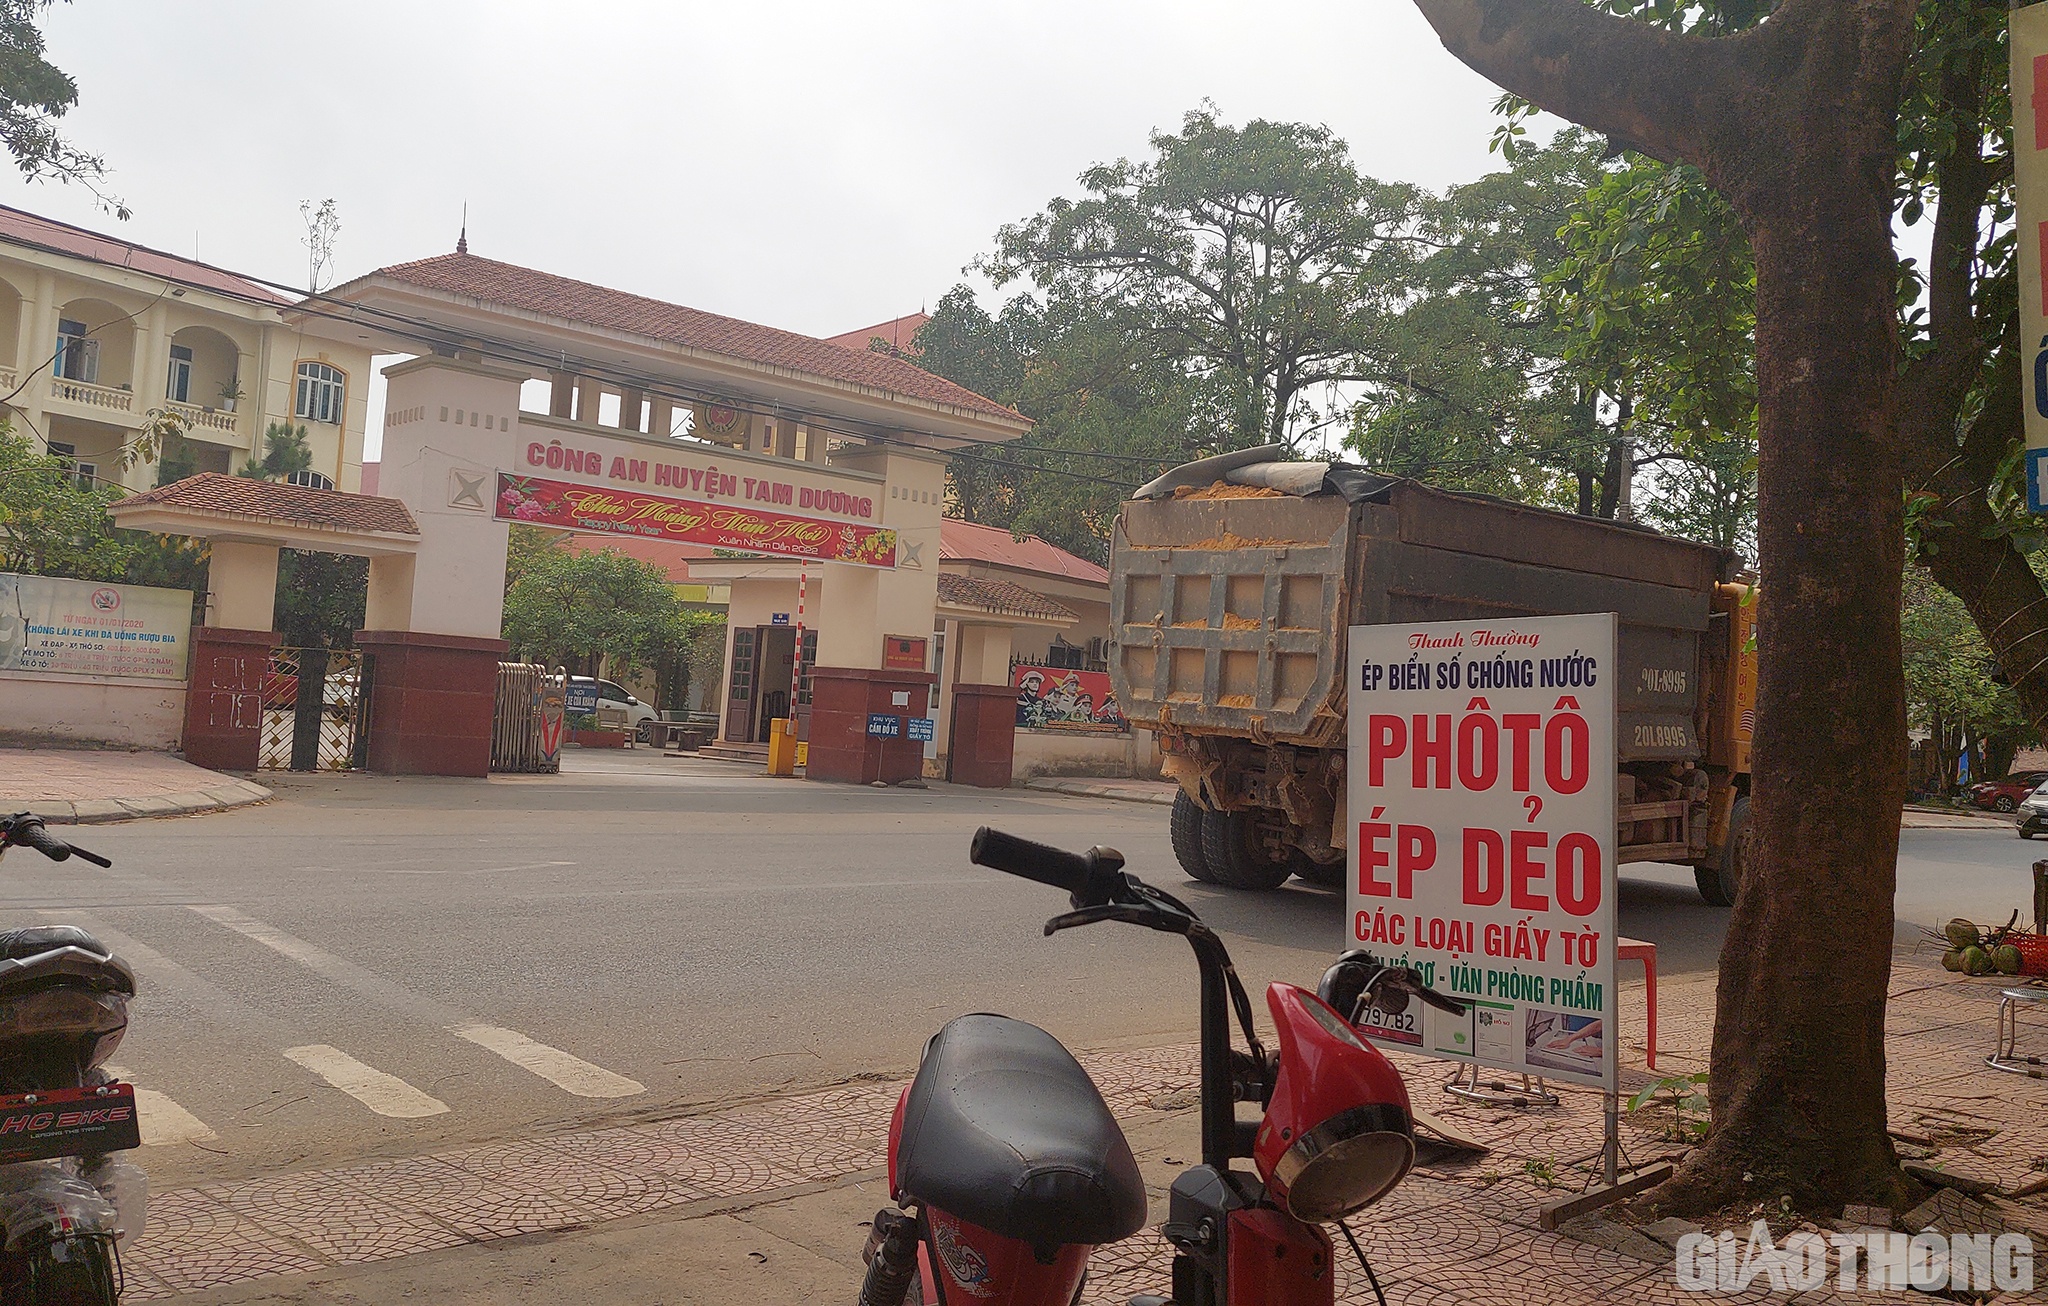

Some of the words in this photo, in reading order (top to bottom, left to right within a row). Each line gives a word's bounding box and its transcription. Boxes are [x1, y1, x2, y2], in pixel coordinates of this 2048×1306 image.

[527, 439, 601, 475] CÔNG
[608, 456, 648, 483] AN
[654, 463, 737, 499] HUYỆN
[743, 477, 793, 506] TAM
[798, 487, 873, 518] DƯƠNG
[563, 490, 630, 519] Chúc
[577, 516, 613, 531] Happy
[613, 521, 638, 533] New
[638, 523, 663, 536] Year
[791, 544, 819, 554] 2022
[99, 617, 144, 629] 01/01/2020
[72, 628, 83, 637] XE
[84, 629, 99, 638] KHI
[162, 634, 176, 643] BIA
[1407, 631, 1466, 650] Thanh
[1470, 629, 1541, 649] Thường
[1361, 659, 1383, 691] ÉP
[1388, 652, 1430, 691] BIỂN
[1436, 652, 1462, 690] SỐ
[1467, 650, 1534, 689] CHỐNG
[1540, 649, 1598, 688] NƯỚC
[890, 726, 899, 735] XE
[1634, 725, 1687, 747] 20L8995
[1369, 695, 1590, 795] PHÔTÔ
[1358, 806, 1437, 900] ÉP
[1462, 795, 1602, 917] DẺO
[1355, 906, 1406, 946] CÁC
[1414, 916, 1474, 959] LOẠI
[1484, 916, 1551, 962] GIẤY
[1560, 924, 1601, 968] TỜ
[1450, 963, 1482, 995] VĂN
[1487, 966, 1545, 1004] PHÒNG
[1551, 971, 1603, 1012] PHẨM
[0, 1112, 54, 1135] HC
[64, 1128, 80, 1136] THE
[81, 1125, 106, 1133] TREND
